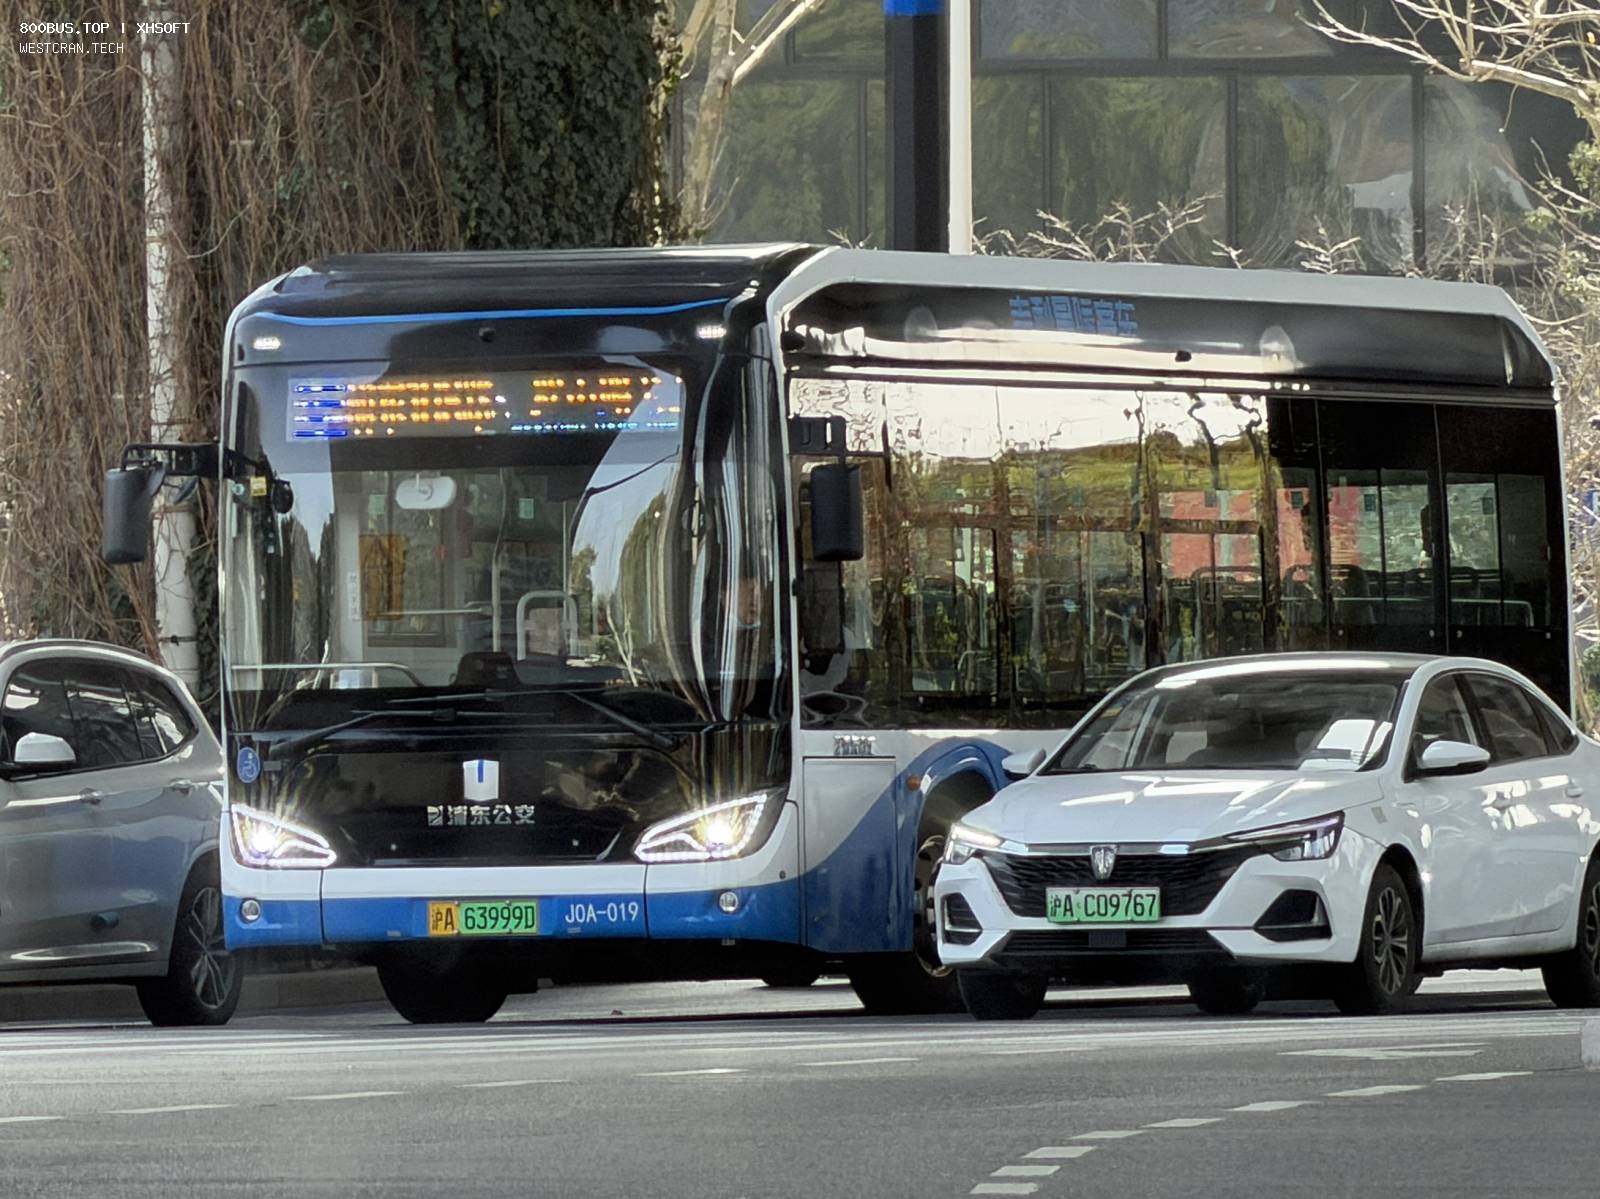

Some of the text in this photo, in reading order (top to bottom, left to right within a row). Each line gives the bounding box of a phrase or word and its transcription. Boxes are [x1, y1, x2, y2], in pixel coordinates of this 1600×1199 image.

[447, 804, 535, 826] 浦东公交
[1084, 893, 1156, 917] C09767
[464, 905, 535, 930] 63999D
